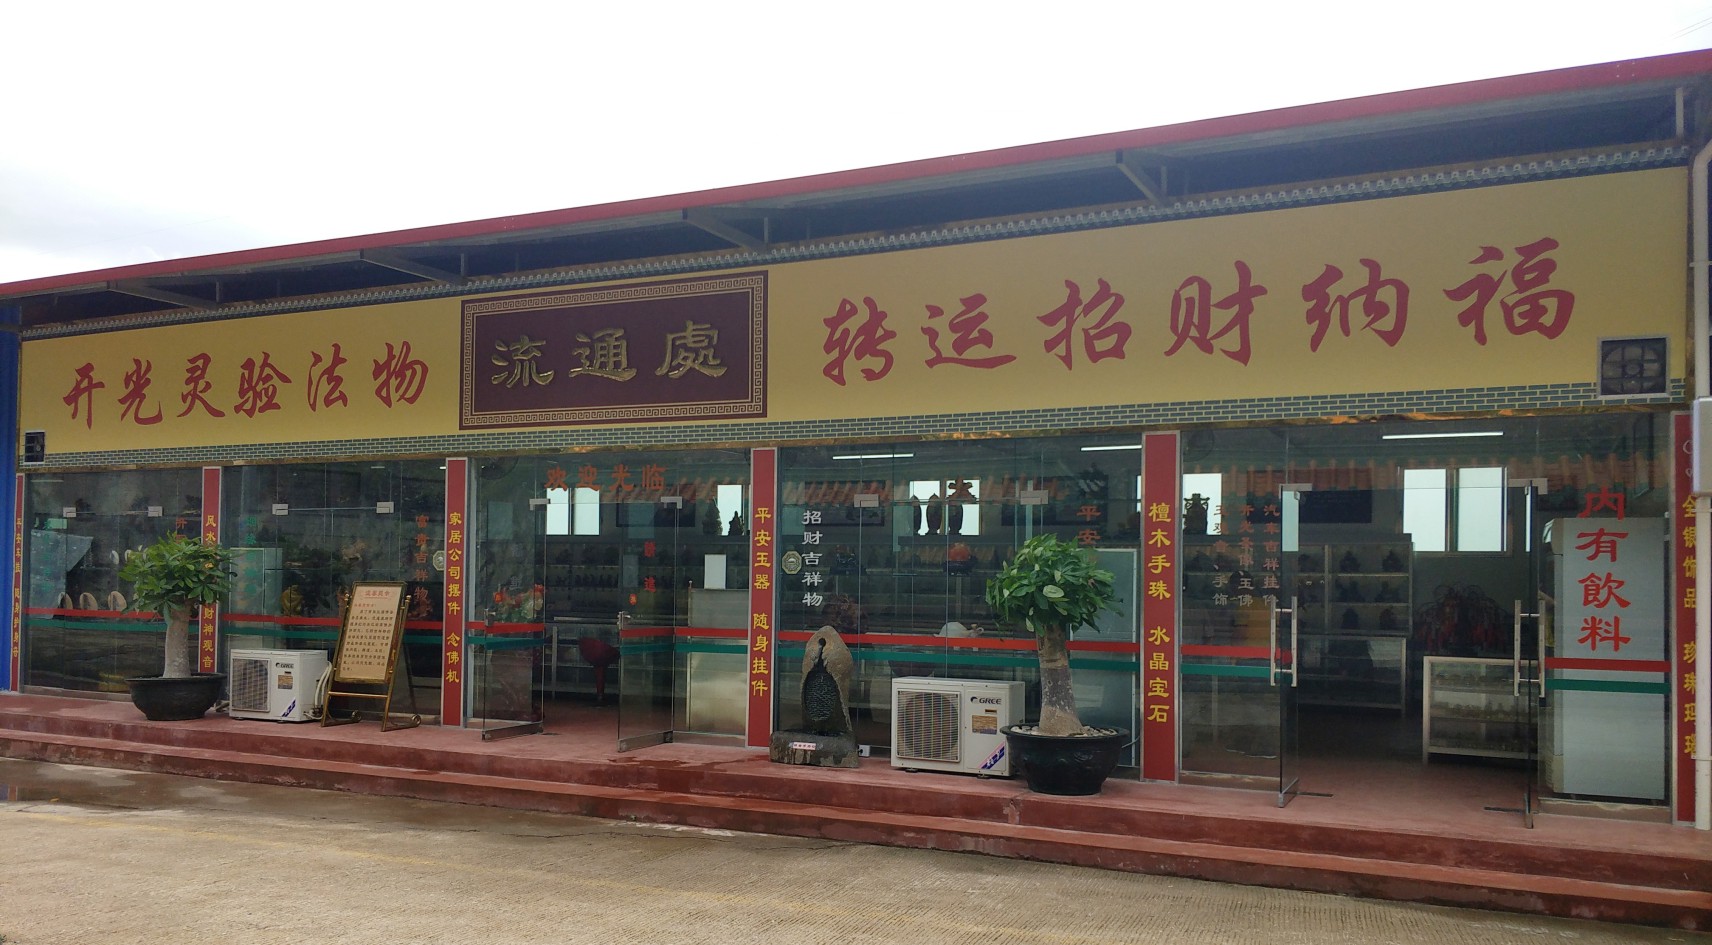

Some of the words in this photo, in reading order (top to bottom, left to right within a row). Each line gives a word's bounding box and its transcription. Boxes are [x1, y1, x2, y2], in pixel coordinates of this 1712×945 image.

[491, 321, 728, 389] 流通處
[822, 236, 1576, 387] 转运招财纳福
[63, 341, 429, 430] 开光灵验法物
[544, 463, 667, 492] 欢迎光临
[801, 509, 824, 608] 招财吉祥物
[1575, 486, 1632, 652] 内有飲料
[979, 697, 1002, 705] GREE
